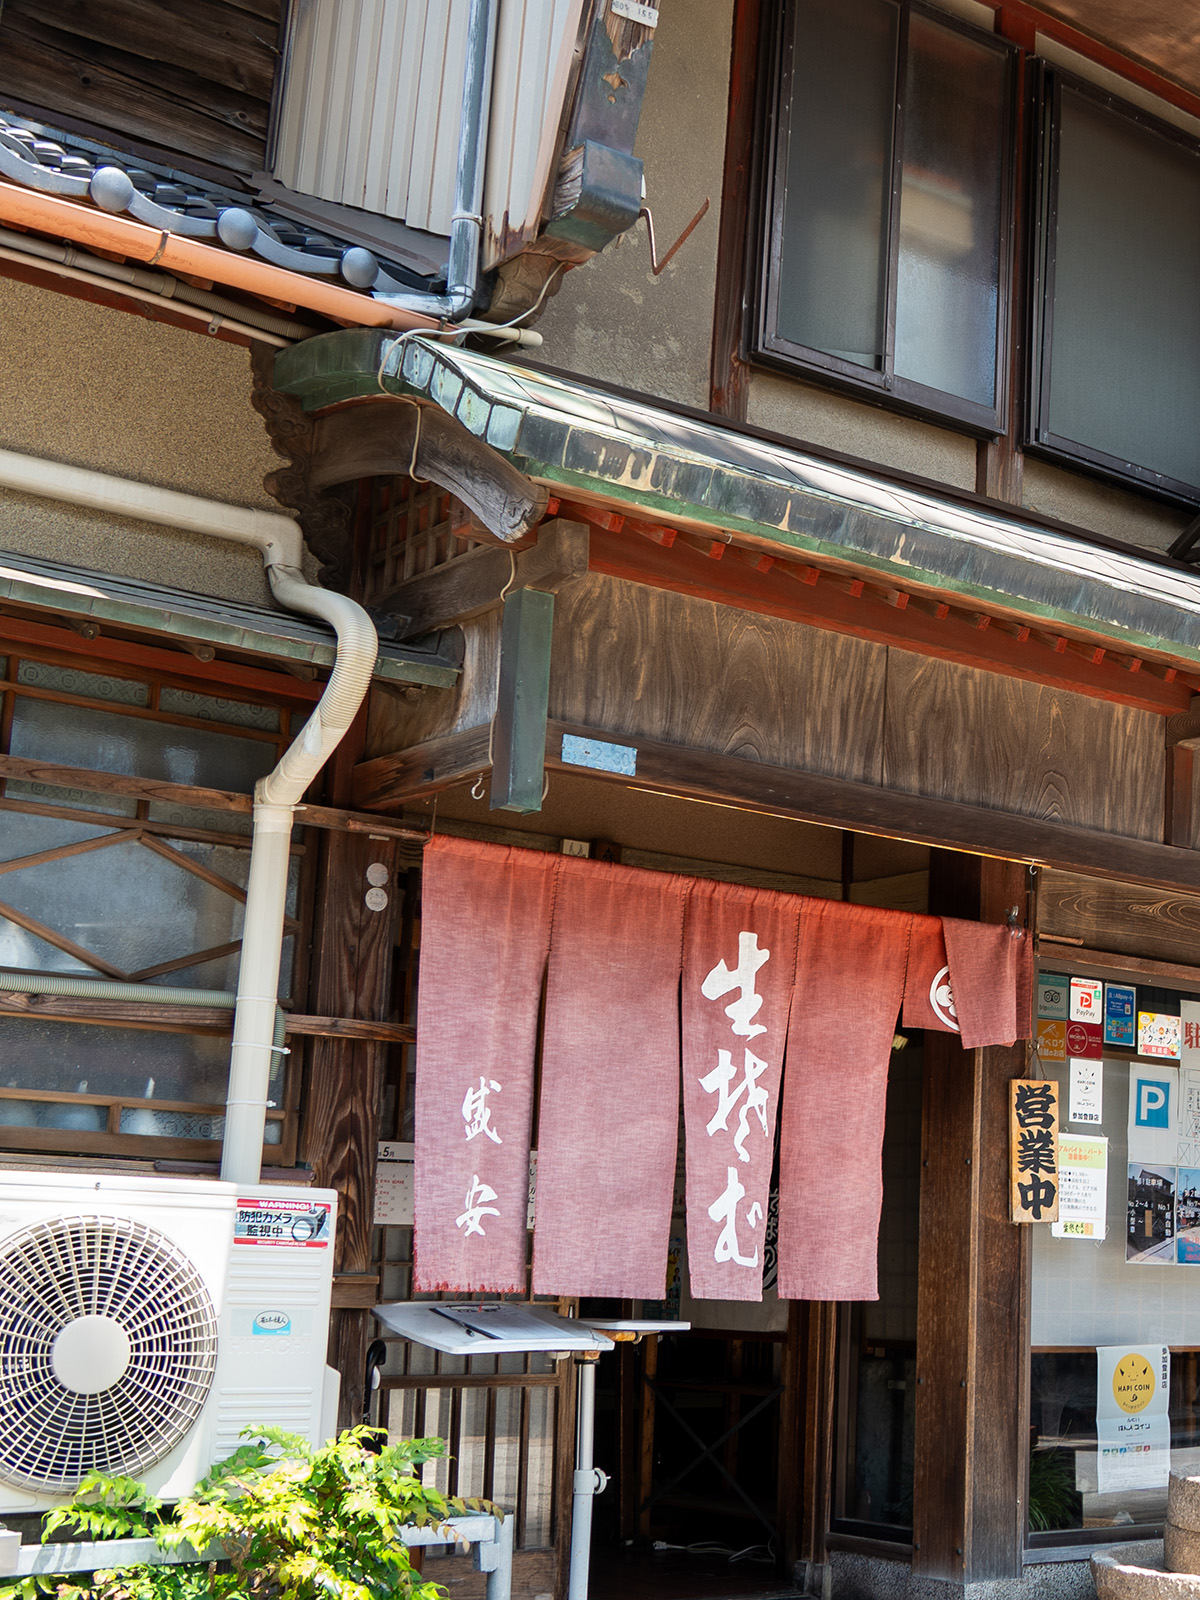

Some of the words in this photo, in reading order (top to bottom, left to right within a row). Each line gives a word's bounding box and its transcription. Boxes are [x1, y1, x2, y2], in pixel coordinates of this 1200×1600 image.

[1076, 1008, 1096, 1018] PayPay
[1037, 1035, 1065, 1048] 食べログ
[1140, 1086, 1166, 1121] P
[1014, 1084, 1057, 1221] 営業中
[258, 1200, 310, 1211] WARNING!
[239, 1210, 293, 1224] 防犯カメラ
[246, 1224, 283, 1238] 監視中
[227, 1337, 312, 1355] HITACHI
[1117, 1385, 1133, 1393] HAPI
[1134, 1383, 1150, 1391] COIN
